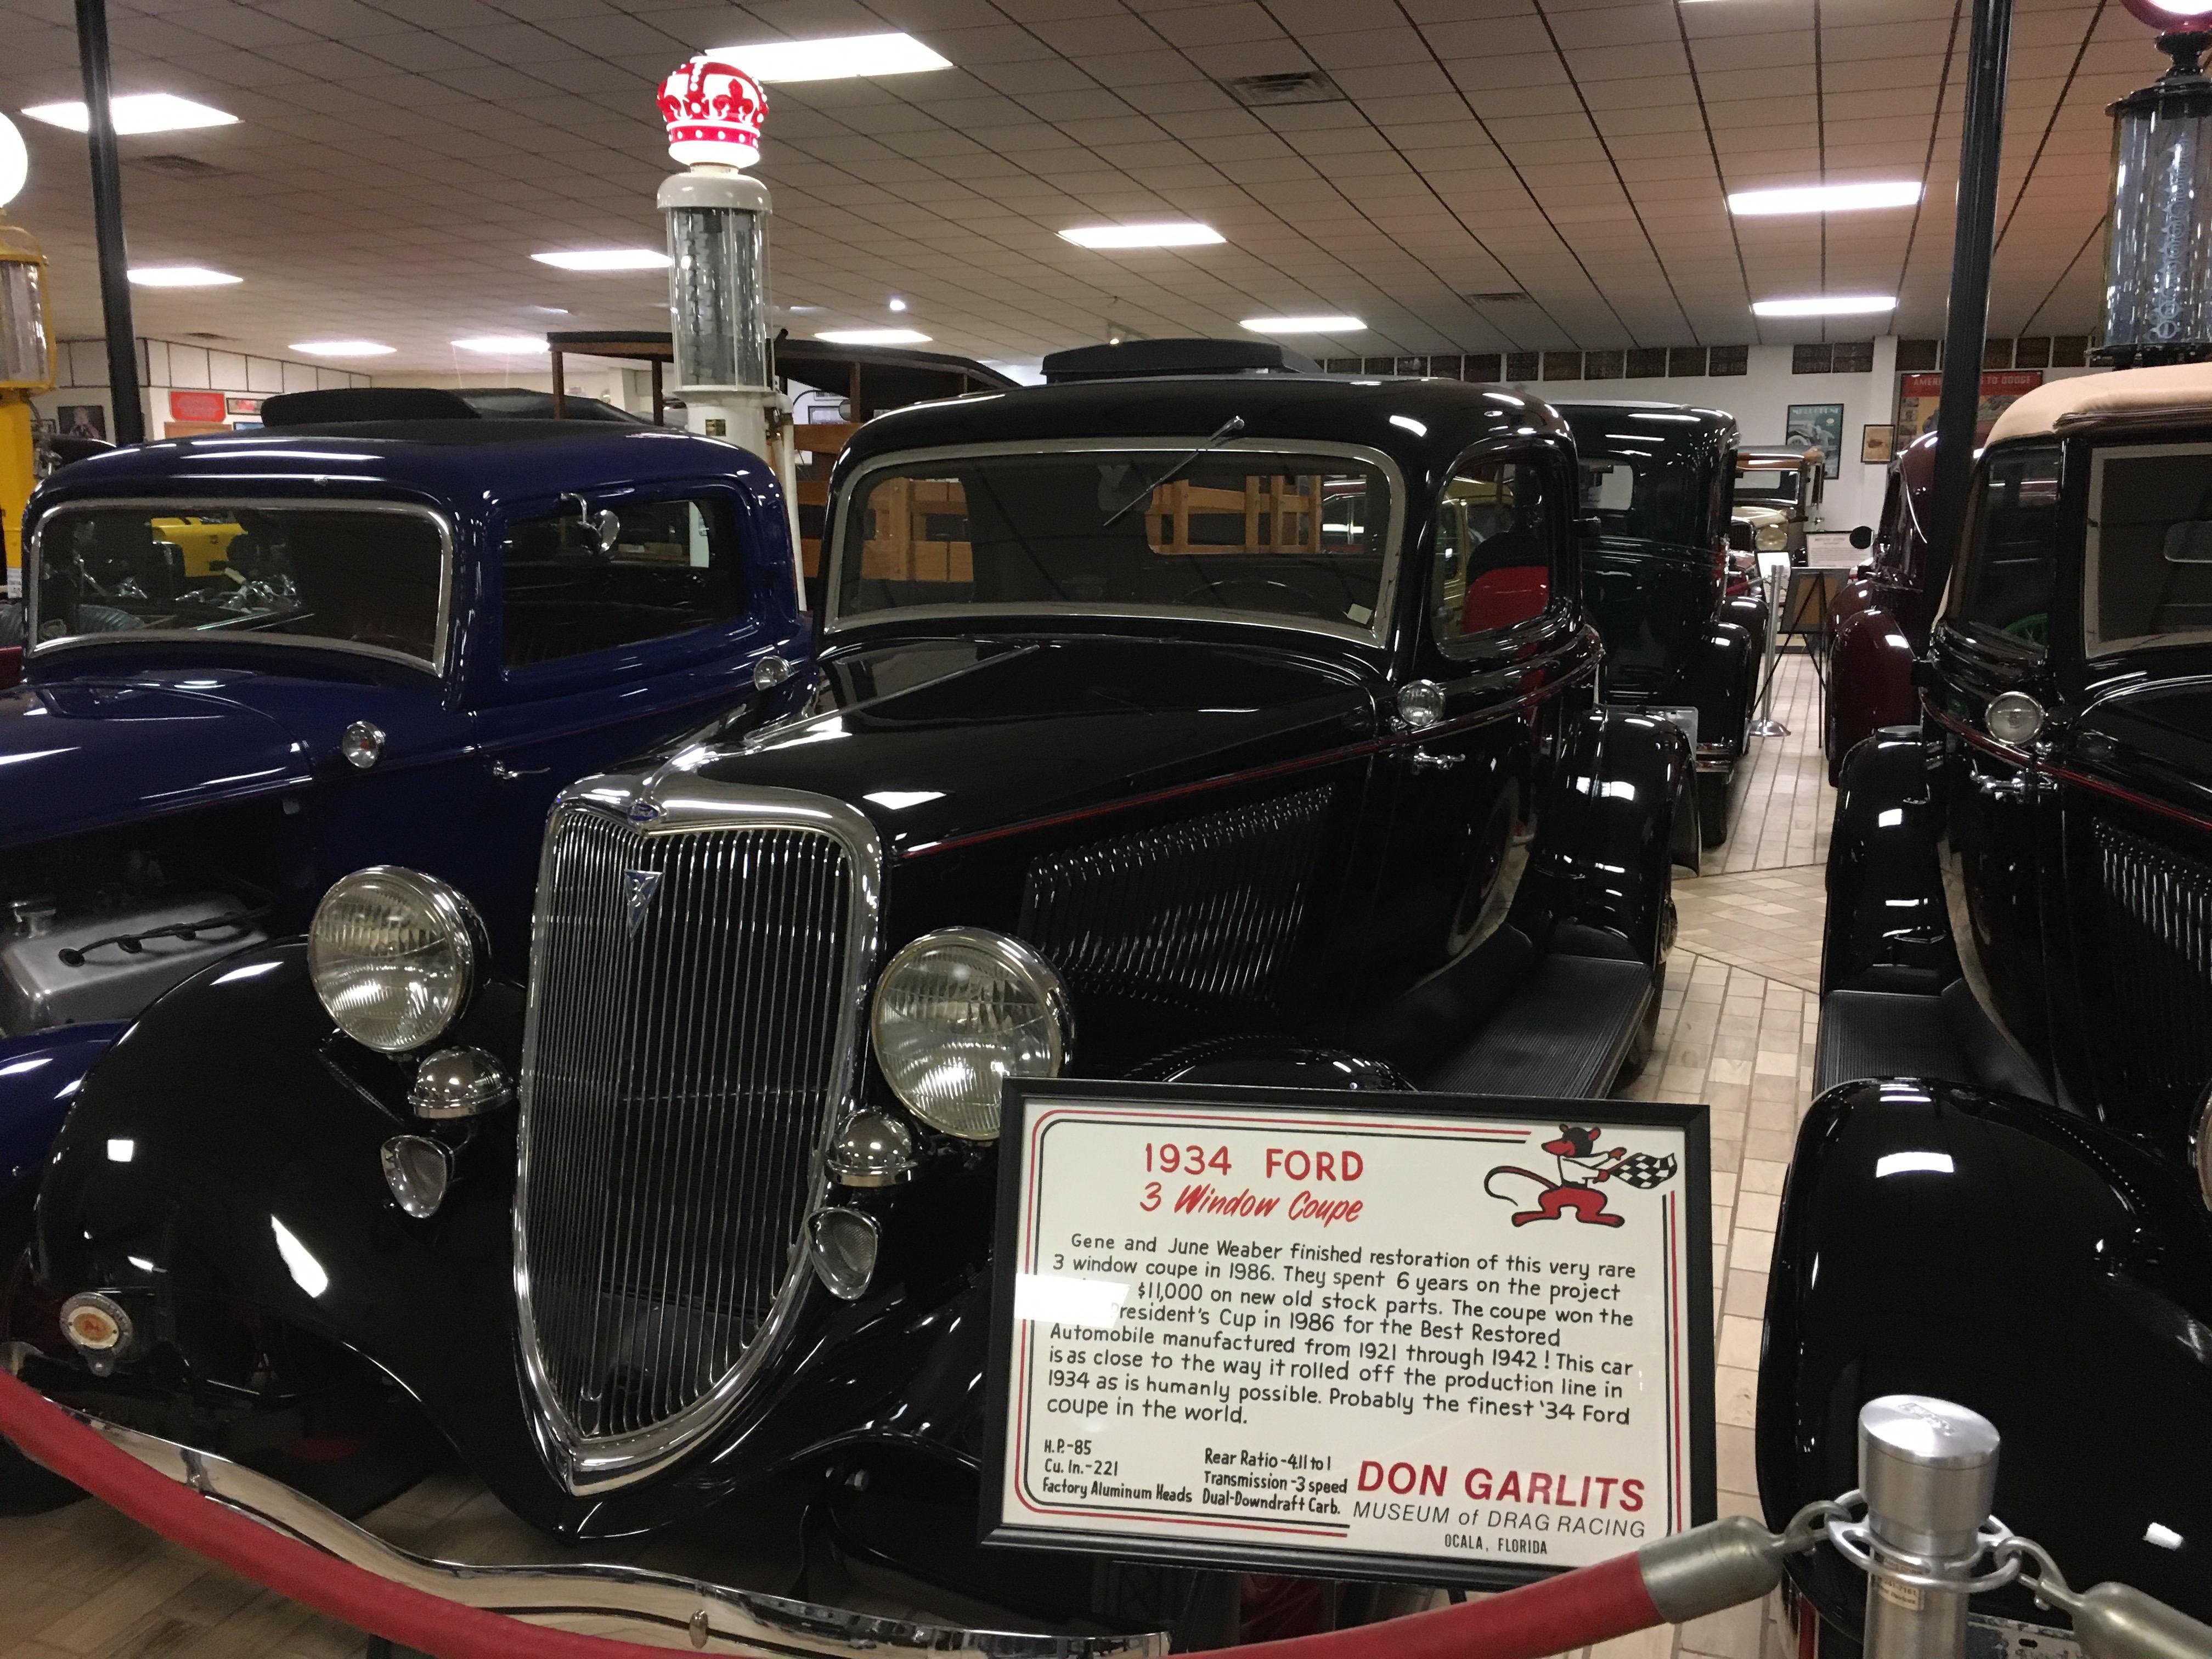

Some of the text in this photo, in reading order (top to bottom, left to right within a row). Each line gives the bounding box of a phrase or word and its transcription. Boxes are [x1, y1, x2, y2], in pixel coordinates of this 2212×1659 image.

[1146, 1143, 1363, 1181] 1934 FORD
[1140, 1182, 1363, 1228] 3 Window Coupe
[1071, 1233, 1635, 1280] Gene and June Weaber finished restoration of this very rare
[1053, 1254, 1621, 1305] 3 window coupe in 1986. They spent 6 years on the project
[1138, 1282, 1633, 1327] $11,000 on new old stock parts. The coupe won the
[1220, 1308, 1256, 1331] Cup
[1265, 1310, 1280, 1329] in
[1290, 1312, 1334, 1331] 1986
[1344, 1315, 1374, 1334] for
[1380, 1319, 1412, 1336] the
[1421, 1320, 1464, 1340] Best
[1472, 1323, 1560, 1347] Restored
[1051, 1323, 1154, 1344] Automobile
[1163, 1330, 1295, 1353] manufactured
[1305, 1338, 1350, 1357] from
[1360, 1342, 1396, 1361] 1921
[1406, 1345, 1483, 1370] through
[1556, 1353, 1594, 1373] This
[1601, 1362, 1633, 1375] car
[1050, 1346, 1622, 1398] is as close to the way it rolled off the production line in
[1047, 1396, 1247, 1424] coupe in the world.
[1049, 1369, 1090, 1389] 1934
[1097, 1376, 1118, 1390] as
[1125, 1373, 1139, 1391] is
[1147, 1375, 1229, 1403] humanly
[1239, 1385, 1321, 1404] possible.
[1330, 1387, 1413, 1415] Probably
[1423, 1393, 1459, 1412] the
[1468, 1396, 1534, 1417] finest
[1583, 1405, 1629, 1425] Ford
[1044, 1438, 1092, 1455] H.P.-85
[1045, 1458, 1064, 1473] Cu.
[1205, 1448, 1237, 1465] Rear
[1240, 1450, 1278, 1468] Ratio
[1310, 1457, 1323, 1470] to
[1328, 1456, 1330, 1470] 1
[1043, 1477, 1192, 1503] Factory Aluminum Heads
[1203, 1488, 1340, 1514] Dual-Downdraft Carb.
[1204, 1471, 1287, 1490] Transmission
[1308, 1479, 1347, 1496] speed
[1357, 1460, 1644, 1512] DON GARLITS
[1353, 1501, 1644, 1538] MUSEUM of DRAG RACING
[1445, 1534, 1547, 1554] OCALA, FLORIDA
